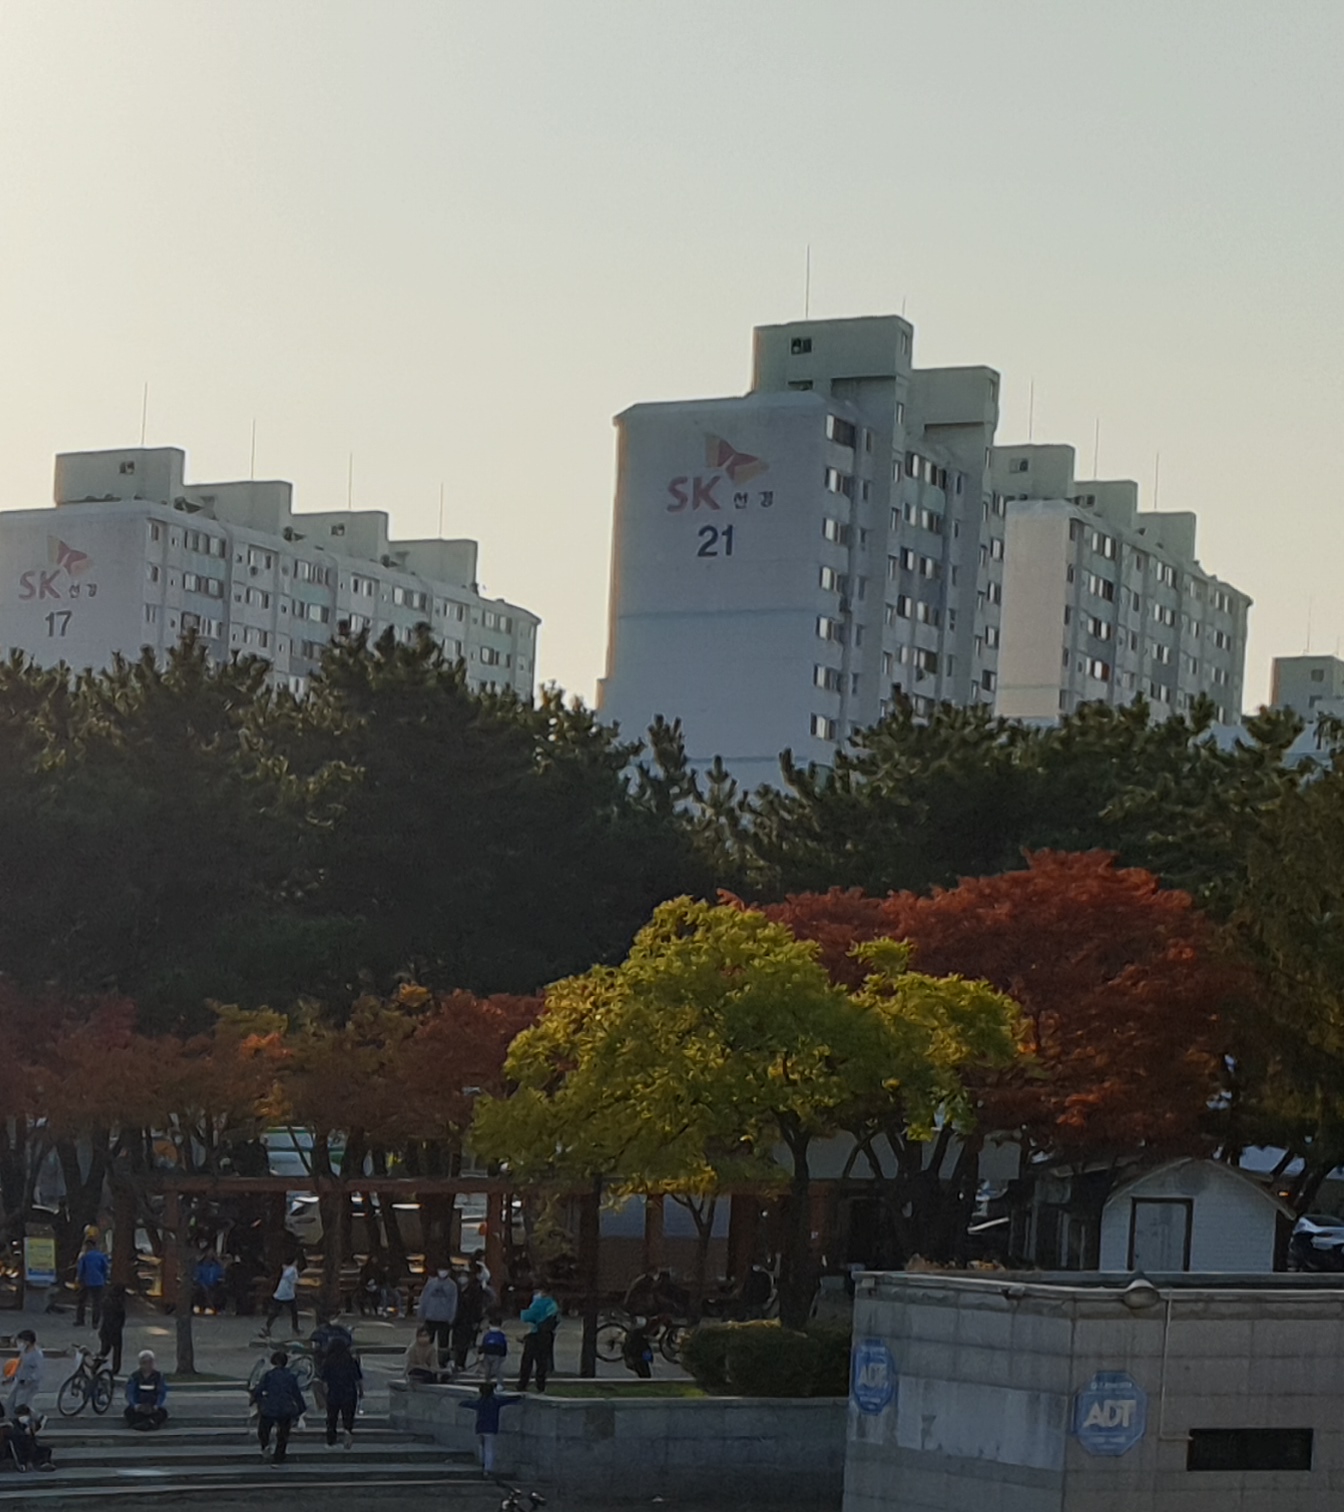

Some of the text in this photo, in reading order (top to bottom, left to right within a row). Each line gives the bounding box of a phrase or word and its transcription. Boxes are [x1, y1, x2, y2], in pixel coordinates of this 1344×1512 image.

[666, 475, 721, 512] SK
[697, 524, 733, 557] 21
[18, 569, 61, 601] SK
[45, 609, 72, 637] 17
[1082, 1399, 1137, 1428] ADT
